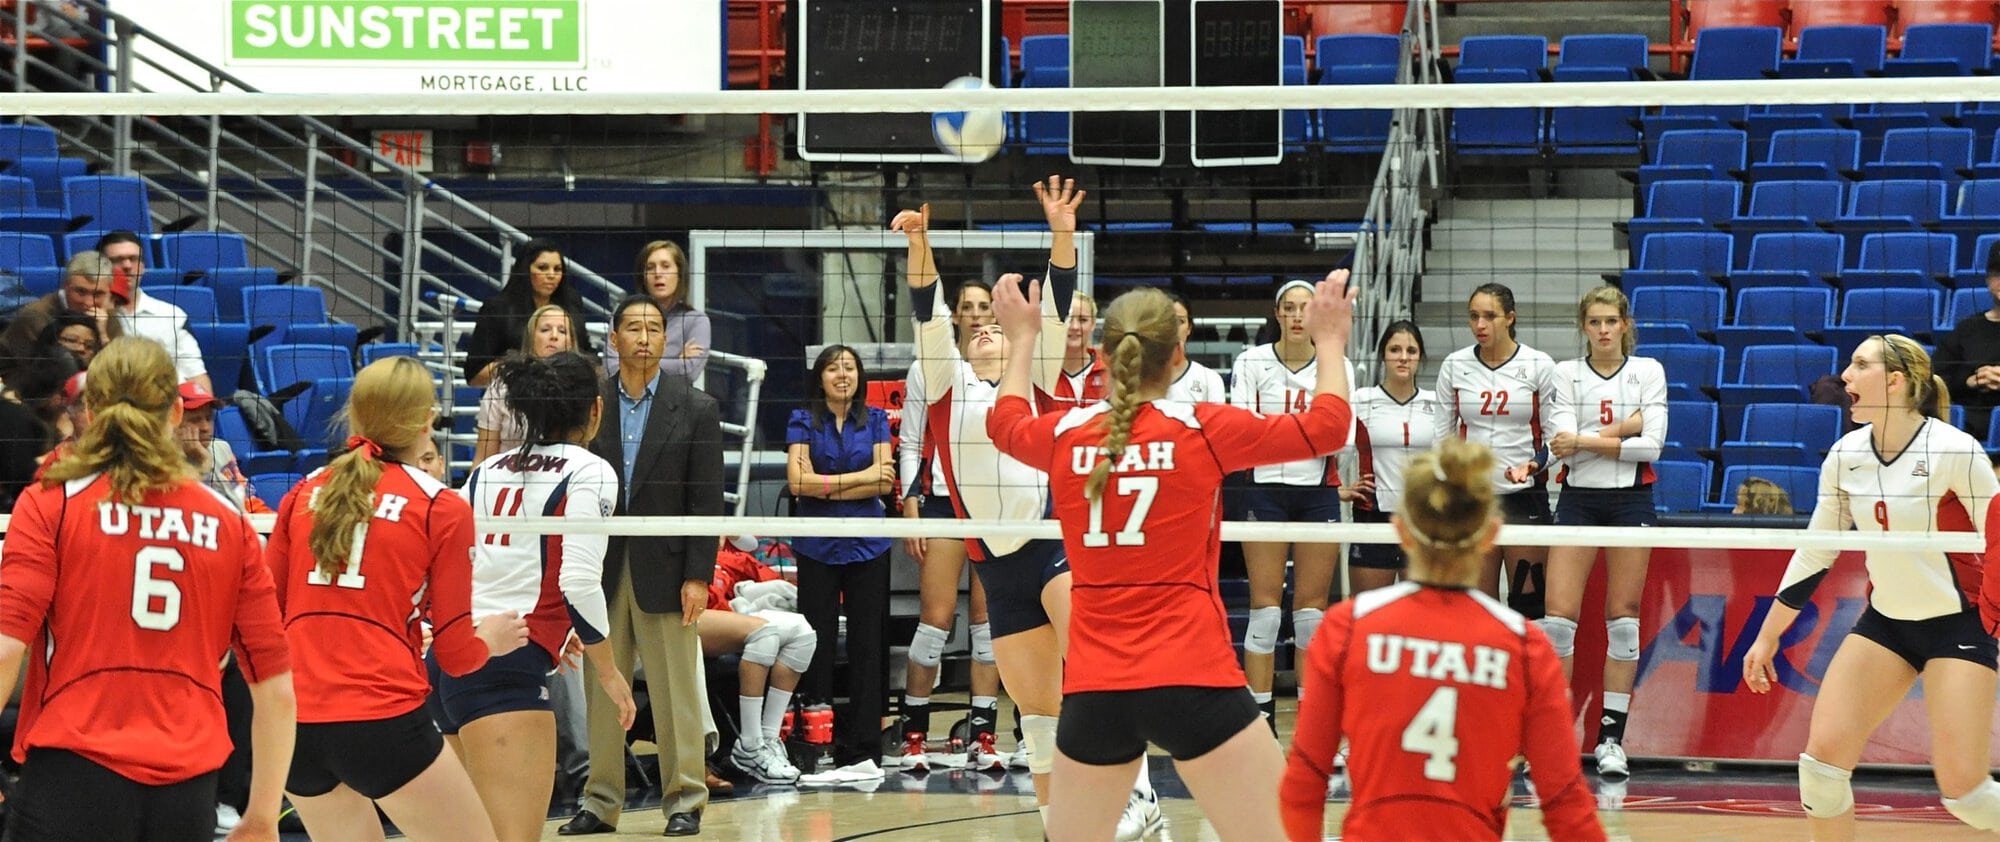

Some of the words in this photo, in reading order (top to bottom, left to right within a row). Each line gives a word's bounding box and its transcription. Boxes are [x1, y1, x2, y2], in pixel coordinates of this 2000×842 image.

[245, 4, 564, 50] SUNSTREET
[420, 75, 544, 92] MORTGAGE,
[552, 76, 588, 92] LLC
[380, 132, 424, 166] EXIT
[1284, 388, 1308, 415] 14
[1480, 390, 1510, 416] 22
[1599, 399, 1614, 426] 5
[97, 500, 220, 551] UTAH
[1083, 476, 1160, 547] 17
[1873, 500, 1890, 531] 9
[131, 545, 185, 631] 6
[1366, 633, 1511, 690] UTAH
[1401, 685, 1459, 783] 4
